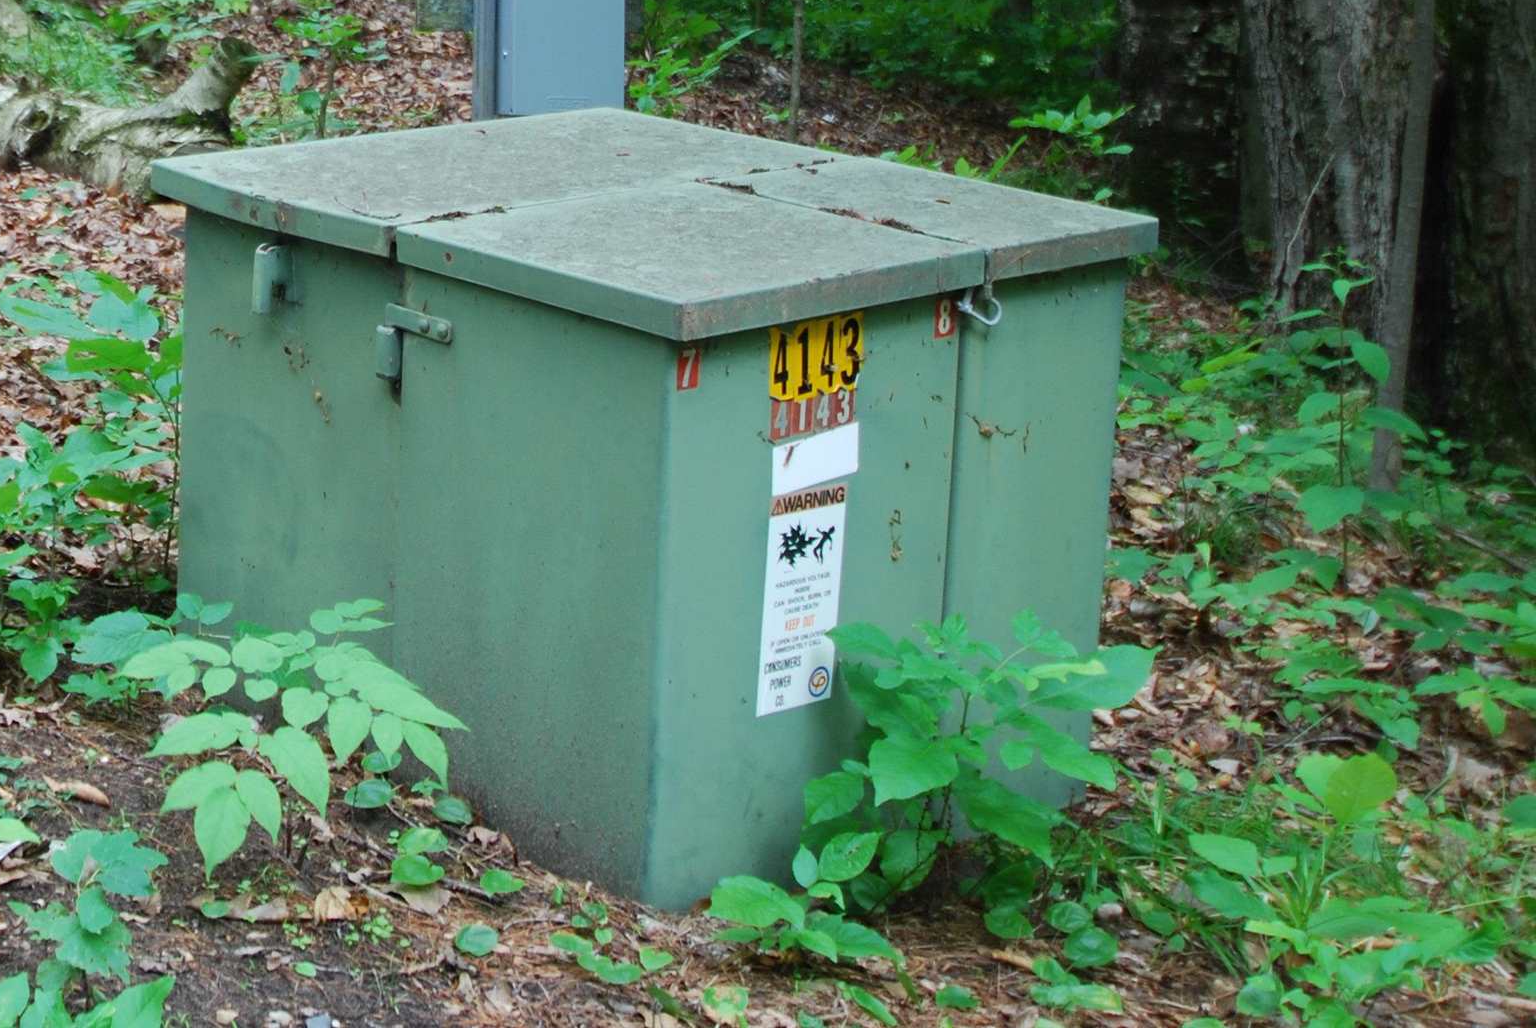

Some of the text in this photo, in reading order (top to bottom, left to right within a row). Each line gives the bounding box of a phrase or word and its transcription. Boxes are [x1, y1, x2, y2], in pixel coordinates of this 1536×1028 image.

[937, 298, 951, 335] 8
[681, 348, 696, 388] 7
[773, 318, 860, 395] 4143
[775, 388, 850, 437] 4143
[782, 486, 845, 513] WARNING
[764, 656, 802, 675] CONSUMERS
[770, 676, 792, 691] POWER
